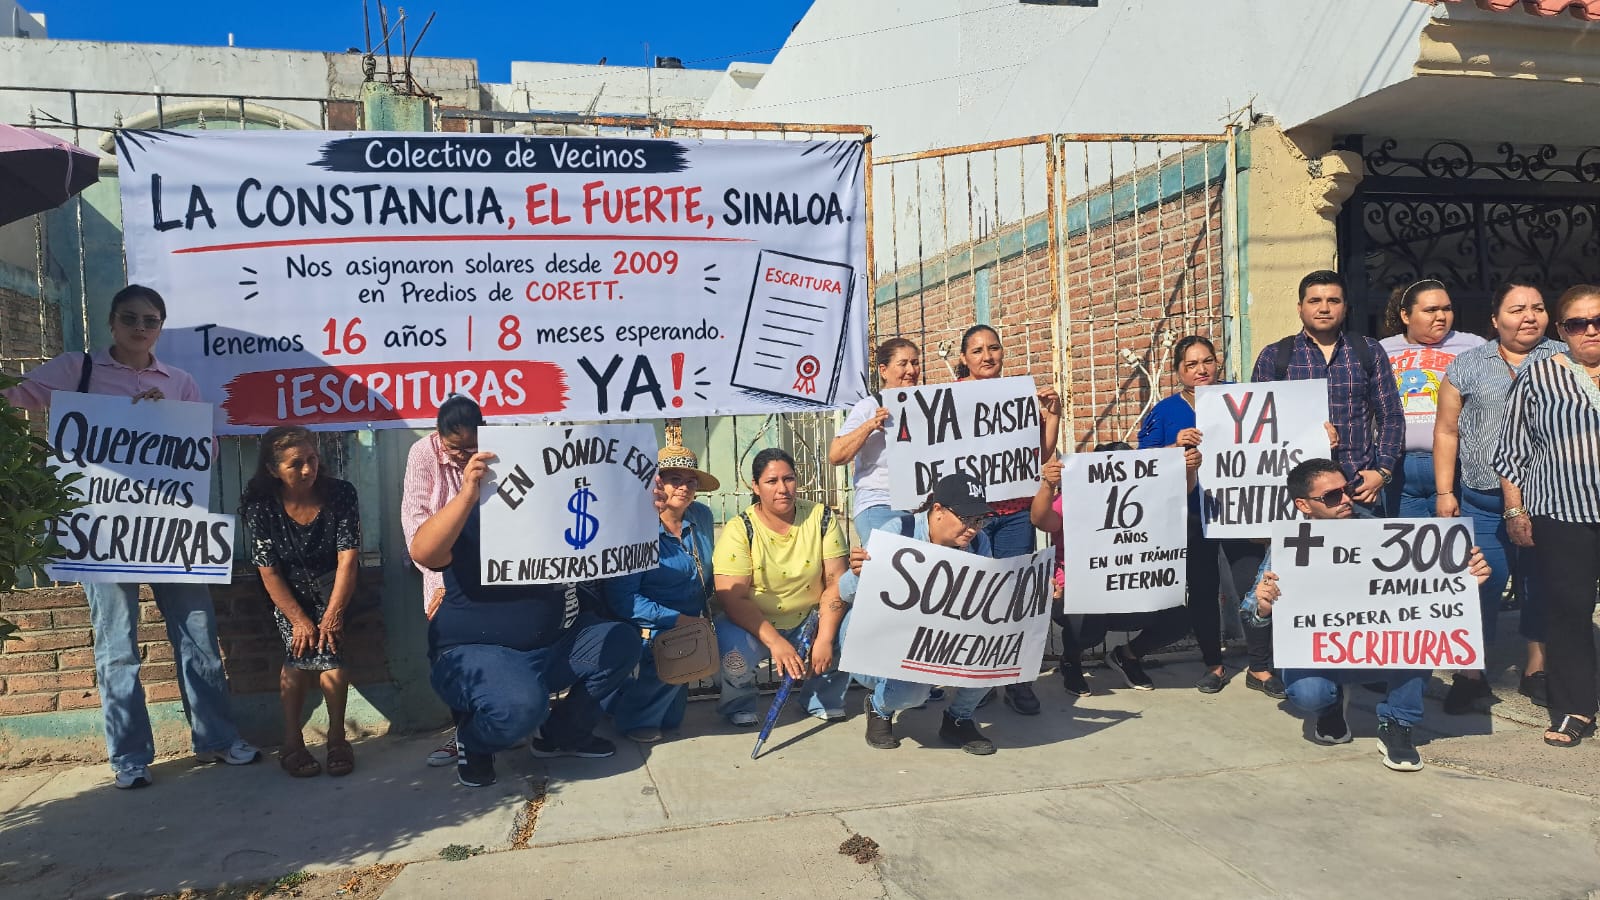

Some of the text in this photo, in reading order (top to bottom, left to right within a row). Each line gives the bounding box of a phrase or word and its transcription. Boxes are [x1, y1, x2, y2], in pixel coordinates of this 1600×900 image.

[365, 139, 647, 169] Colectivo de Vecinos
[151, 173, 852, 232] LA CONSTANCIA, EL FUERTE, SINALOA.
[286, 250, 679, 285] Nos asignaron solares desde 2009
[765, 267, 842, 295] ESCRITURA
[358, 279, 624, 303] en Predios de CORETT.
[194, 314, 725, 357] Tenemos 16 años 8 meses esperando.
[275, 352, 685, 420] ¡ESCRITURAS YA!
[897, 388, 1039, 446] ¡YA BASTA
[1222, 391, 1278, 444] YA
[54, 411, 211, 472] Queremos
[497, 429, 658, 511] EN DÓNDE ESTÁ
[574, 476, 591, 489] EL
[915, 459, 945, 495] DE
[1088, 454, 1159, 484] MÁS DE
[1216, 450, 1246, 478] NO
[88, 476, 194, 509] nuestras
[1096, 485, 1144, 532] 16
[564, 488, 600, 550] $
[1113, 530, 1149, 544] AÑOS
[487, 539, 660, 582] DE NUESTRAS ESCRITURAS
[1089, 546, 1188, 569] EN UN TRÁMITE
[1284, 523, 1473, 574] + DE 300
[880, 548, 1052, 625] SOLUCIÓN
[1106, 567, 1179, 591] ETERNO.
[1369, 576, 1466, 596] FAMILIAS
[1293, 602, 1464, 629] EN ESPERA DE SUS
[906, 626, 1025, 669] INMEDIATA
[1312, 629, 1477, 667] ESCRITURAS
